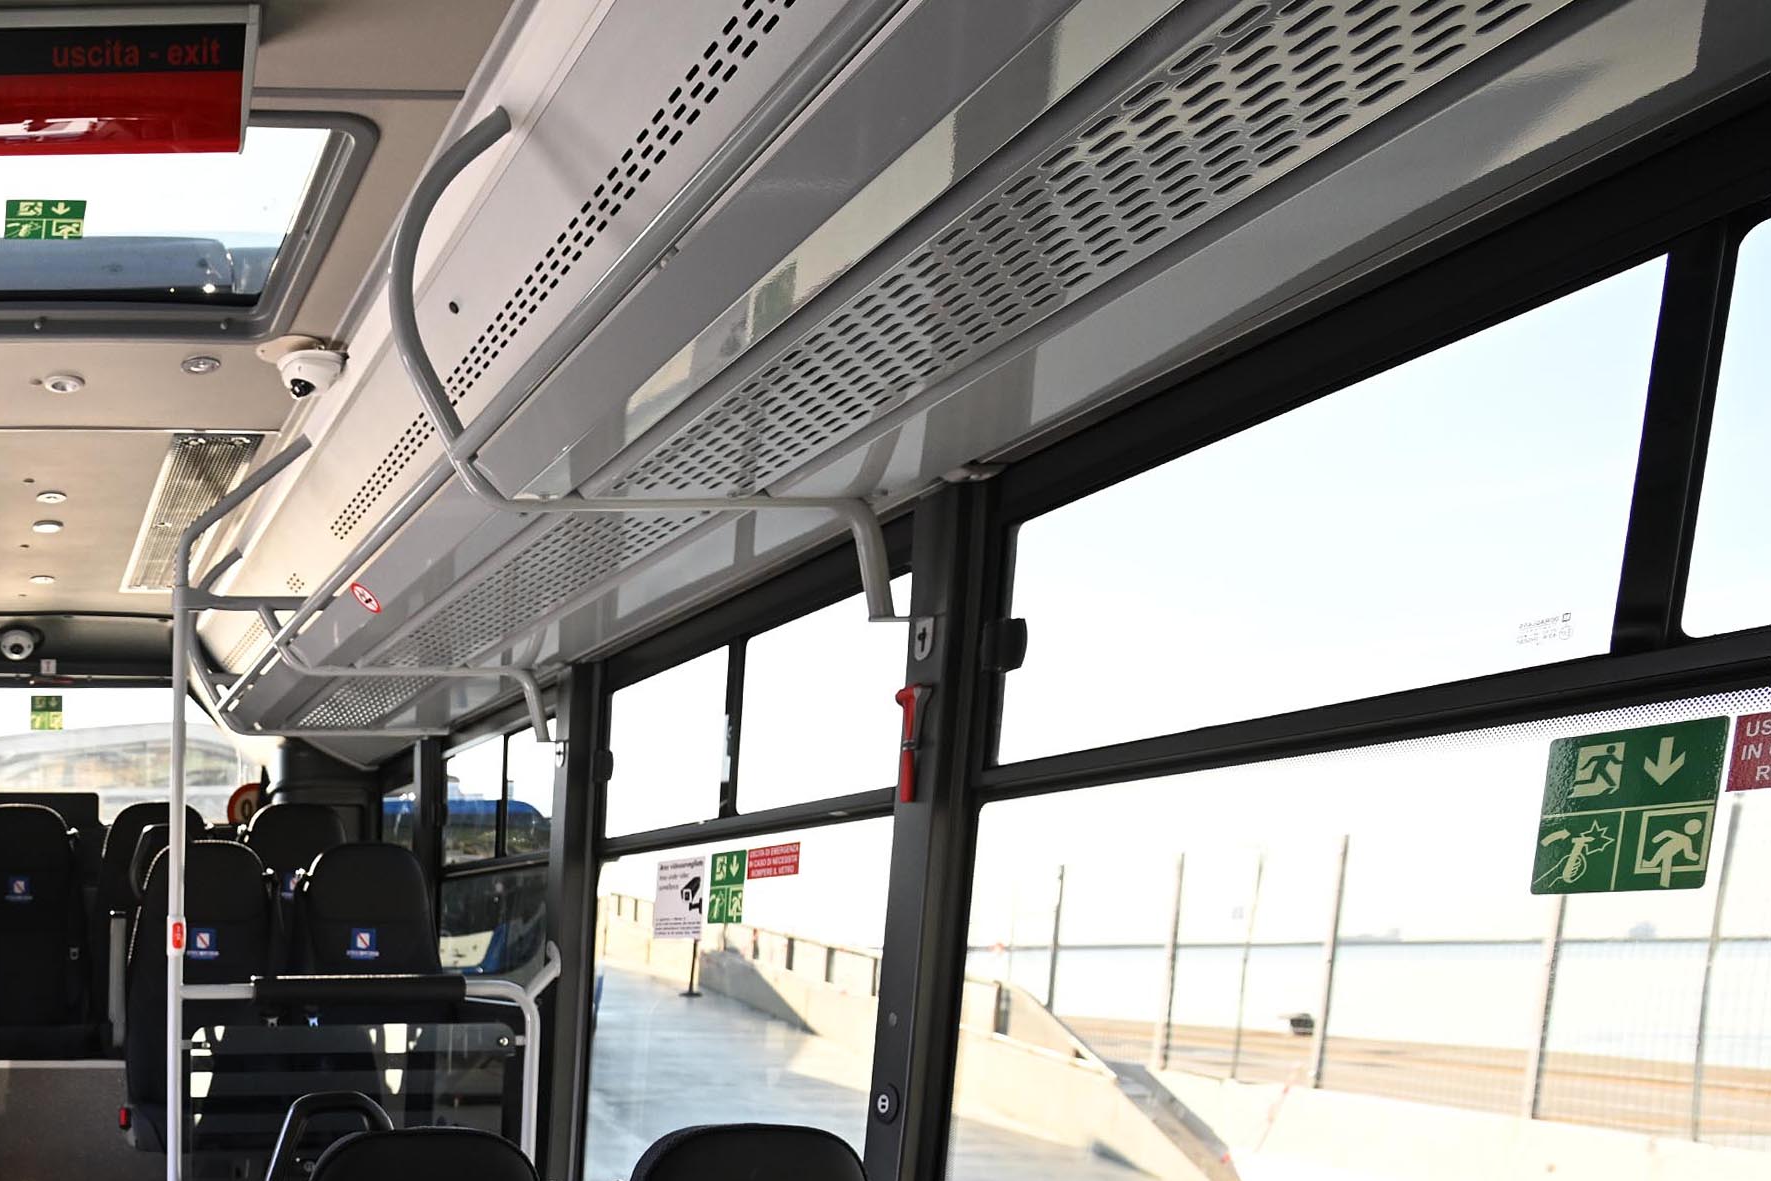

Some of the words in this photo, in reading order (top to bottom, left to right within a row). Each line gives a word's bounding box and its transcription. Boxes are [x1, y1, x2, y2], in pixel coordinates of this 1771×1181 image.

[51, 40, 140, 68] uscita
[166, 37, 221, 65] exit
[1741, 742, 1763, 761] IN
